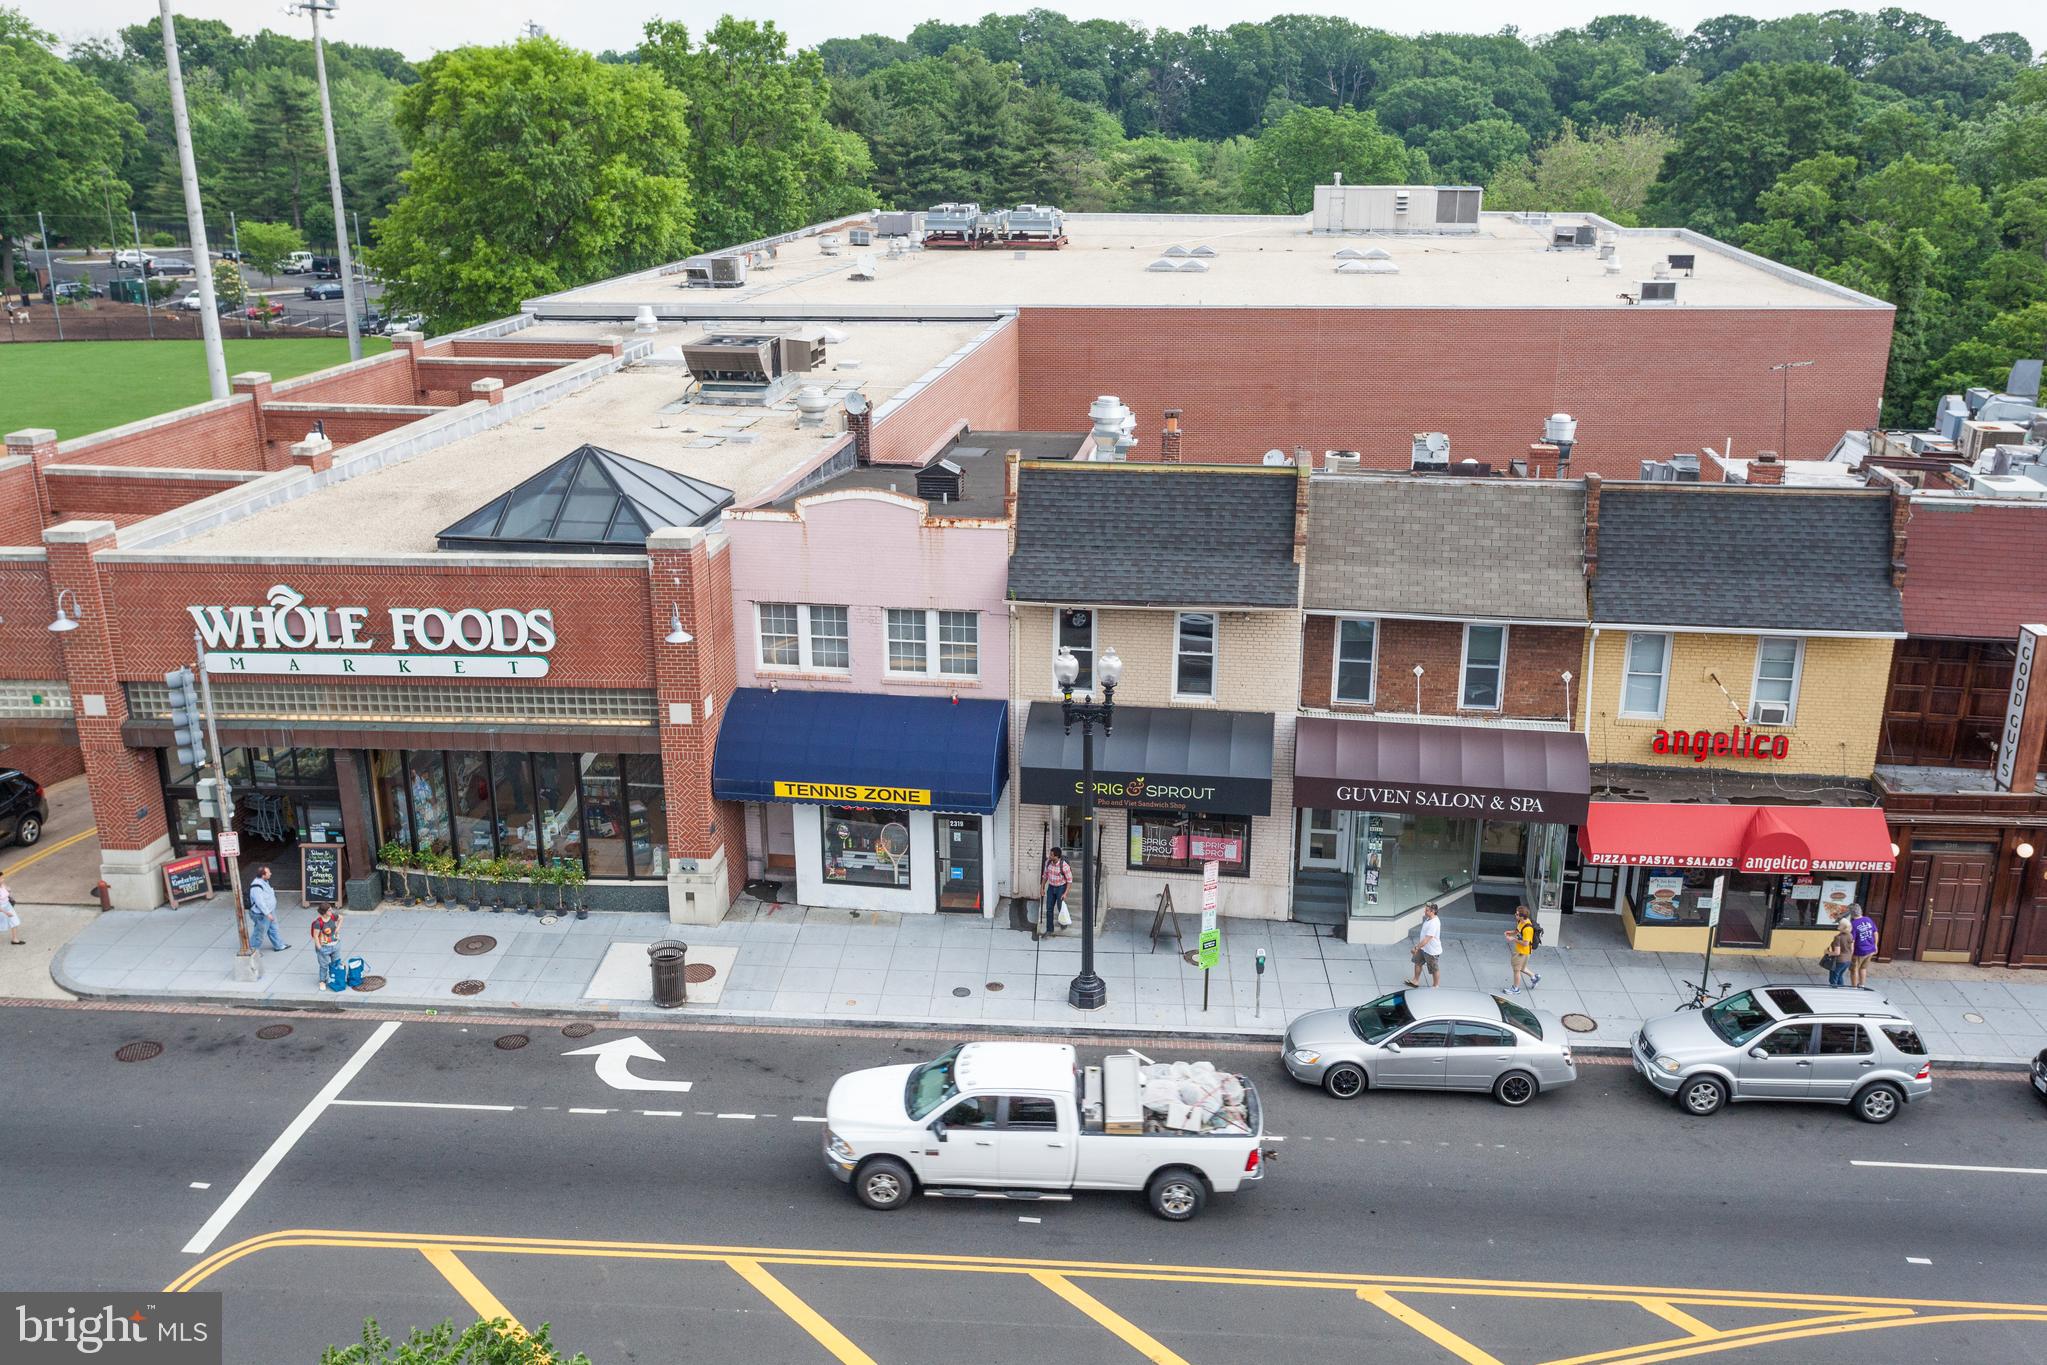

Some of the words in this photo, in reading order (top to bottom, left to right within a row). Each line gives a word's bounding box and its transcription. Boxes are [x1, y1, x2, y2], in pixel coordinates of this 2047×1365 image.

[187, 585, 373, 649] WHOLE
[388, 607, 556, 653] FOODS
[230, 657, 519, 675] MARKET
[2013, 646, 2030, 707] GOOD
[1652, 725, 1790, 762] angelico
[2001, 714, 2019, 777] GUYS
[784, 783, 857, 799] TENNIS
[863, 788, 921, 802] ZONE
[1126, 777, 1145, 797] &
[1146, 785, 1216, 800] SPROUT
[1124, 799, 1137, 807] Viet
[1138, 800, 1169, 808] Sandwich
[1170, 801, 1186, 809] Shop
[1336, 786, 1411, 804] GUVEN
[1415, 790, 1486, 809] SALON
[1490, 796, 1505, 810] &
[1510, 797, 1544, 813] SPA
[1142, 837, 1167, 846] SPRIG
[1142, 845, 1177, 855] SPROUT
[1202, 841, 1226, 849] SPRIG
[1592, 854, 1628, 864] PIZZA
[1639, 856, 1675, 865] PASTA
[1686, 857, 1734, 867] SALADS
[1745, 855, 1808, 872] angelico
[1812, 860, 1892, 871] SANDWICHES
